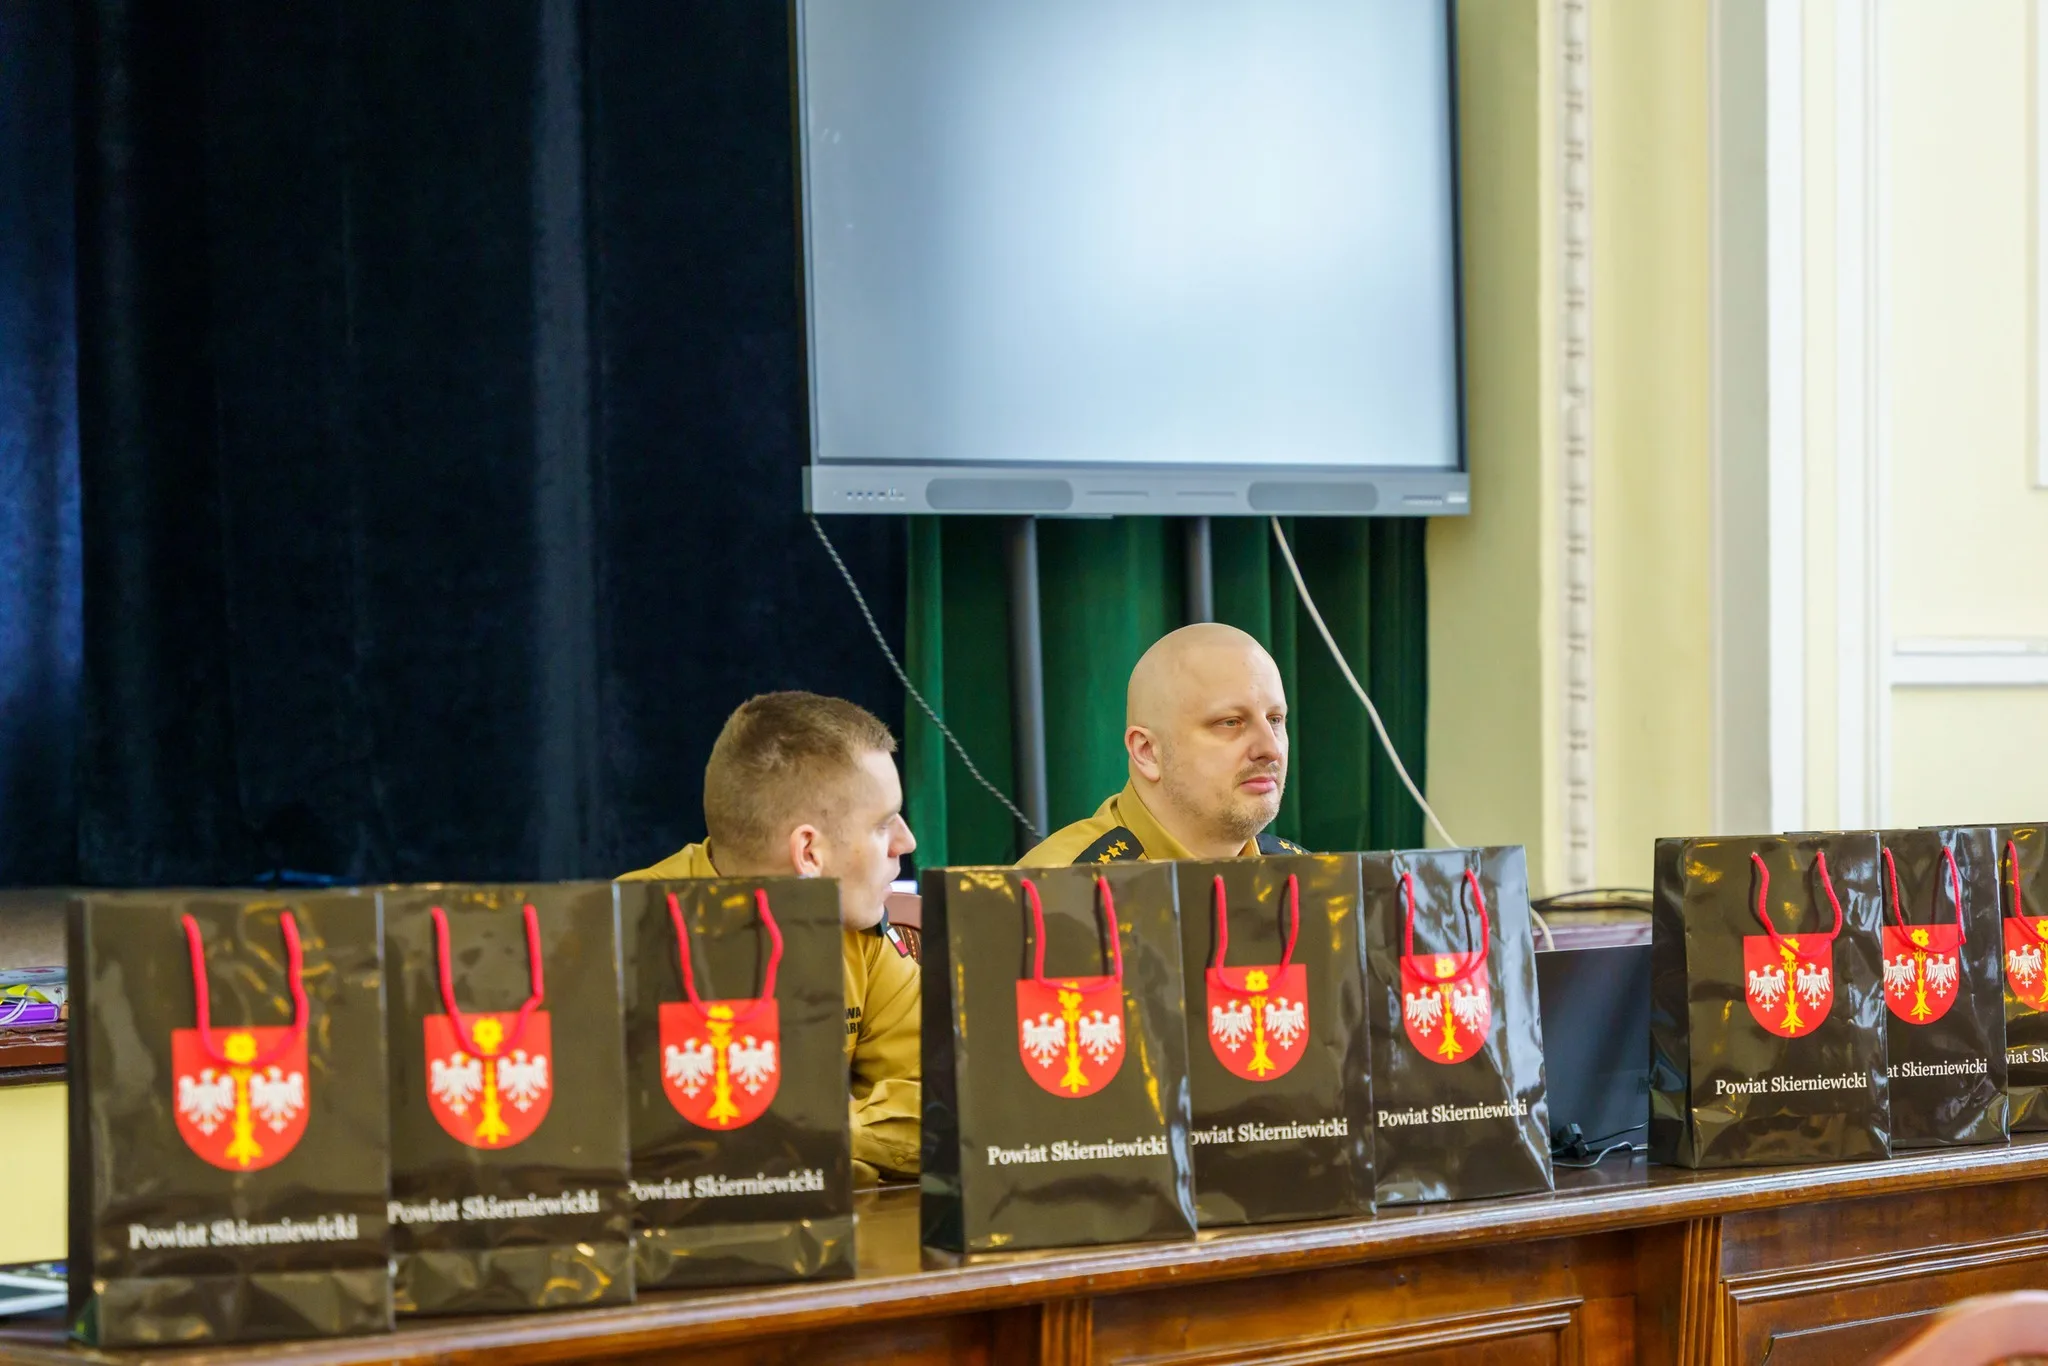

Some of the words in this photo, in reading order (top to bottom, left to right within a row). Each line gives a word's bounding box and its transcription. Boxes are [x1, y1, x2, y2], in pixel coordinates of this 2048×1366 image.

[1901, 1058, 1988, 1077] Skierniewicki
[1715, 1079, 1768, 1095] Powiat
[1771, 1073, 1867, 1092] Skierniewicki
[1377, 1107, 1429, 1128] Powiat
[1431, 1099, 1528, 1123] Skierniewicki
[1190, 1124, 1235, 1146] owiat
[1237, 1117, 1349, 1142] Skierniewicki
[987, 1142, 1048, 1166] Powiat
[1050, 1135, 1168, 1162] Skierniewicki
[693, 1168, 824, 1198] Skierniewicki
[386, 1196, 459, 1225] Powiat
[461, 1188, 599, 1221] Skierniewicki
[128, 1221, 208, 1250] Powiat
[210, 1213, 358, 1248] Skierniewicki
